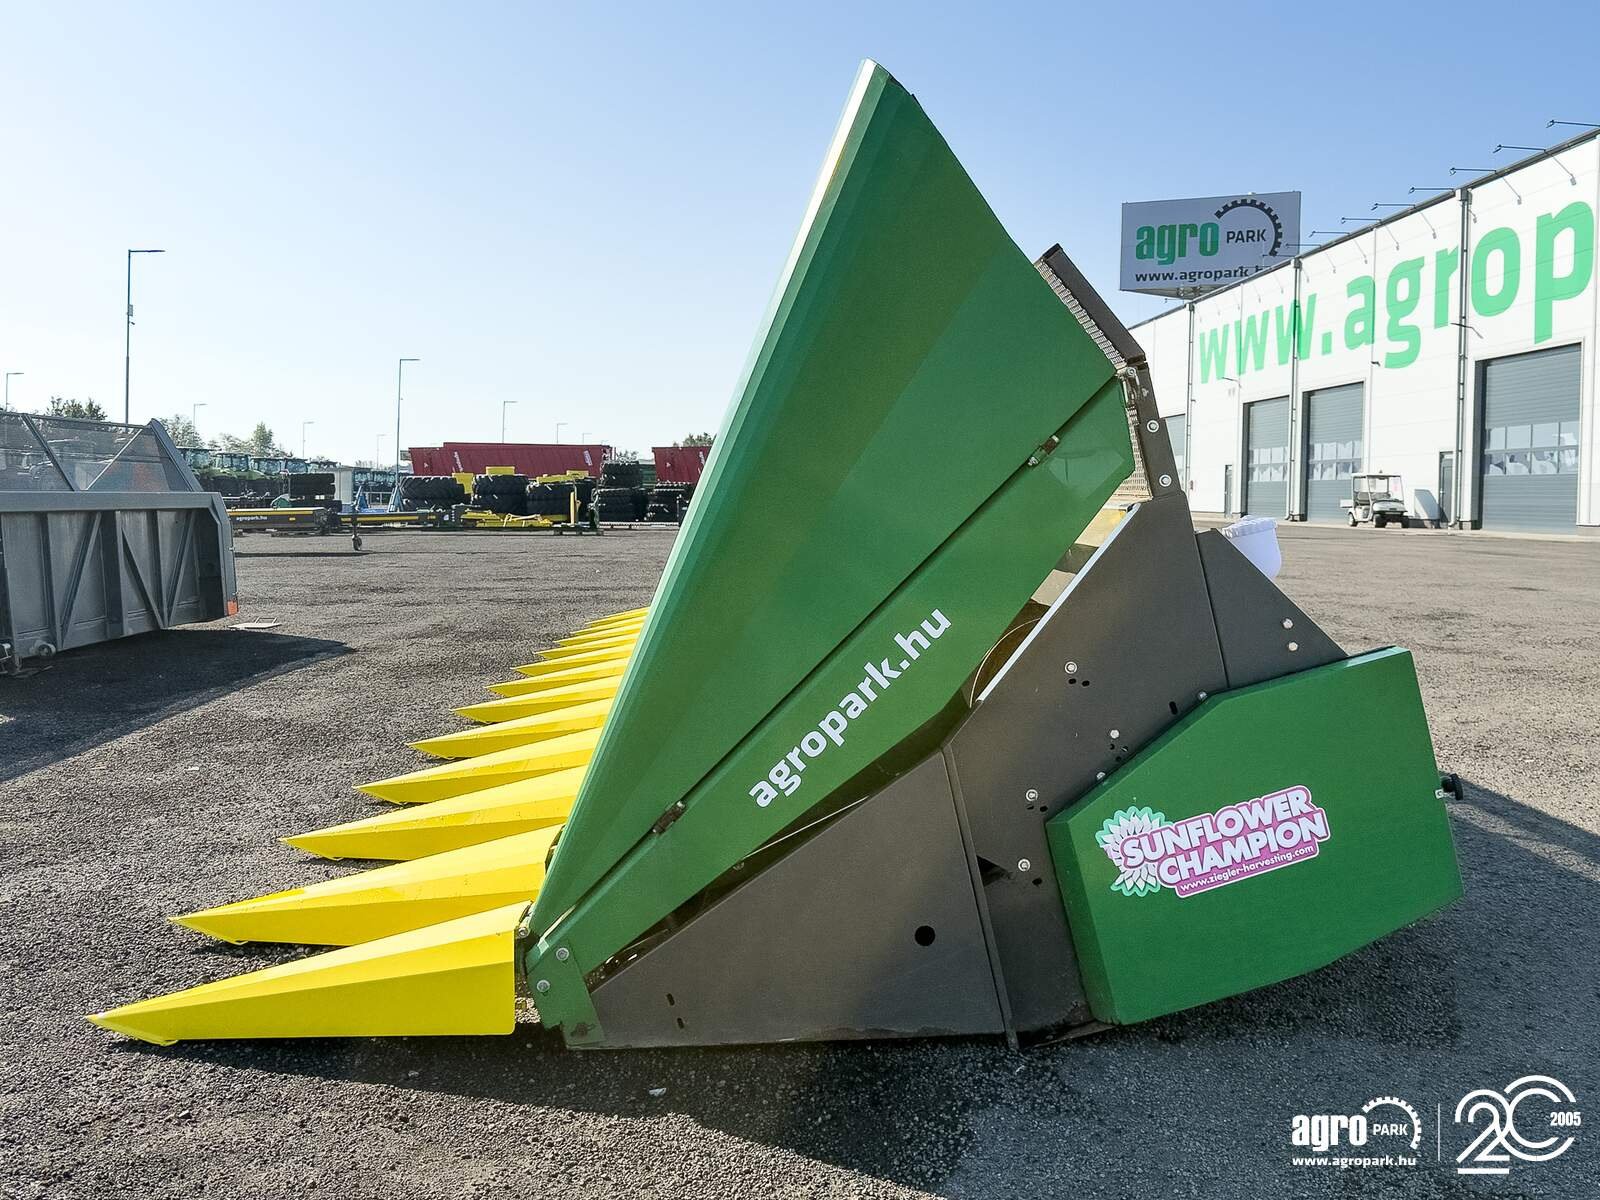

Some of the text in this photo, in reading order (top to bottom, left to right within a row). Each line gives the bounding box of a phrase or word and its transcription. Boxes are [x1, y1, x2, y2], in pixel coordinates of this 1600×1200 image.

[1136, 222, 1267, 265] agro PARK
[748, 608, 952, 808] agropark.hu
[1123, 789, 1315, 867] SUNFLOWER
[1159, 812, 1327, 885] CHAMPION
[1180, 845, 1314, 892] www.ziegler-harvesting.com
